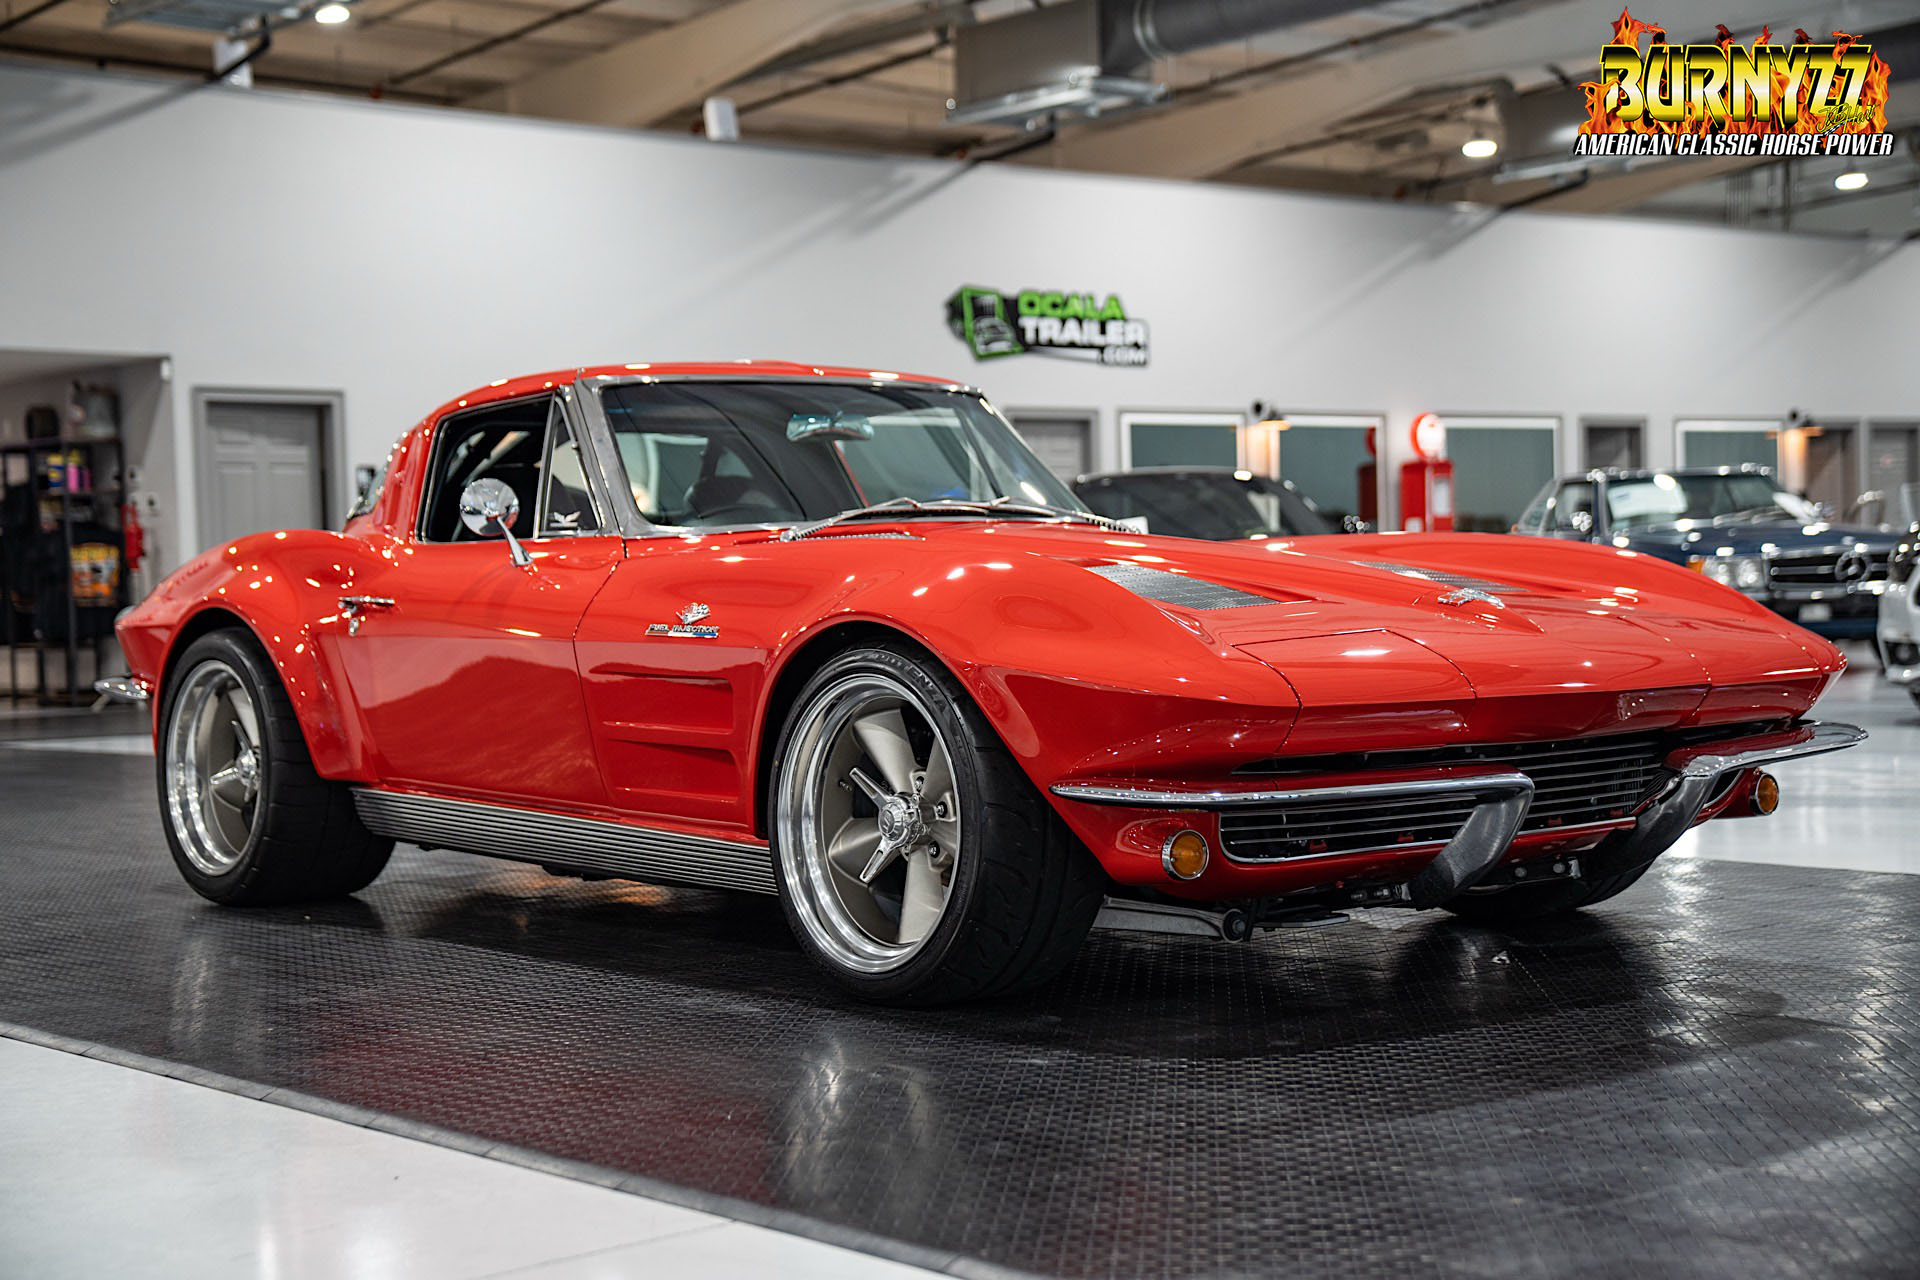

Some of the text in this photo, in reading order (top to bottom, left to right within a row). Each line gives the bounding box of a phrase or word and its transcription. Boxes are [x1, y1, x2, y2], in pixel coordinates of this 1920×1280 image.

[1018, 290, 1126, 320] OCALA
[1018, 316, 1145, 346] TRAILER
[647, 624, 670, 632] FUEL
